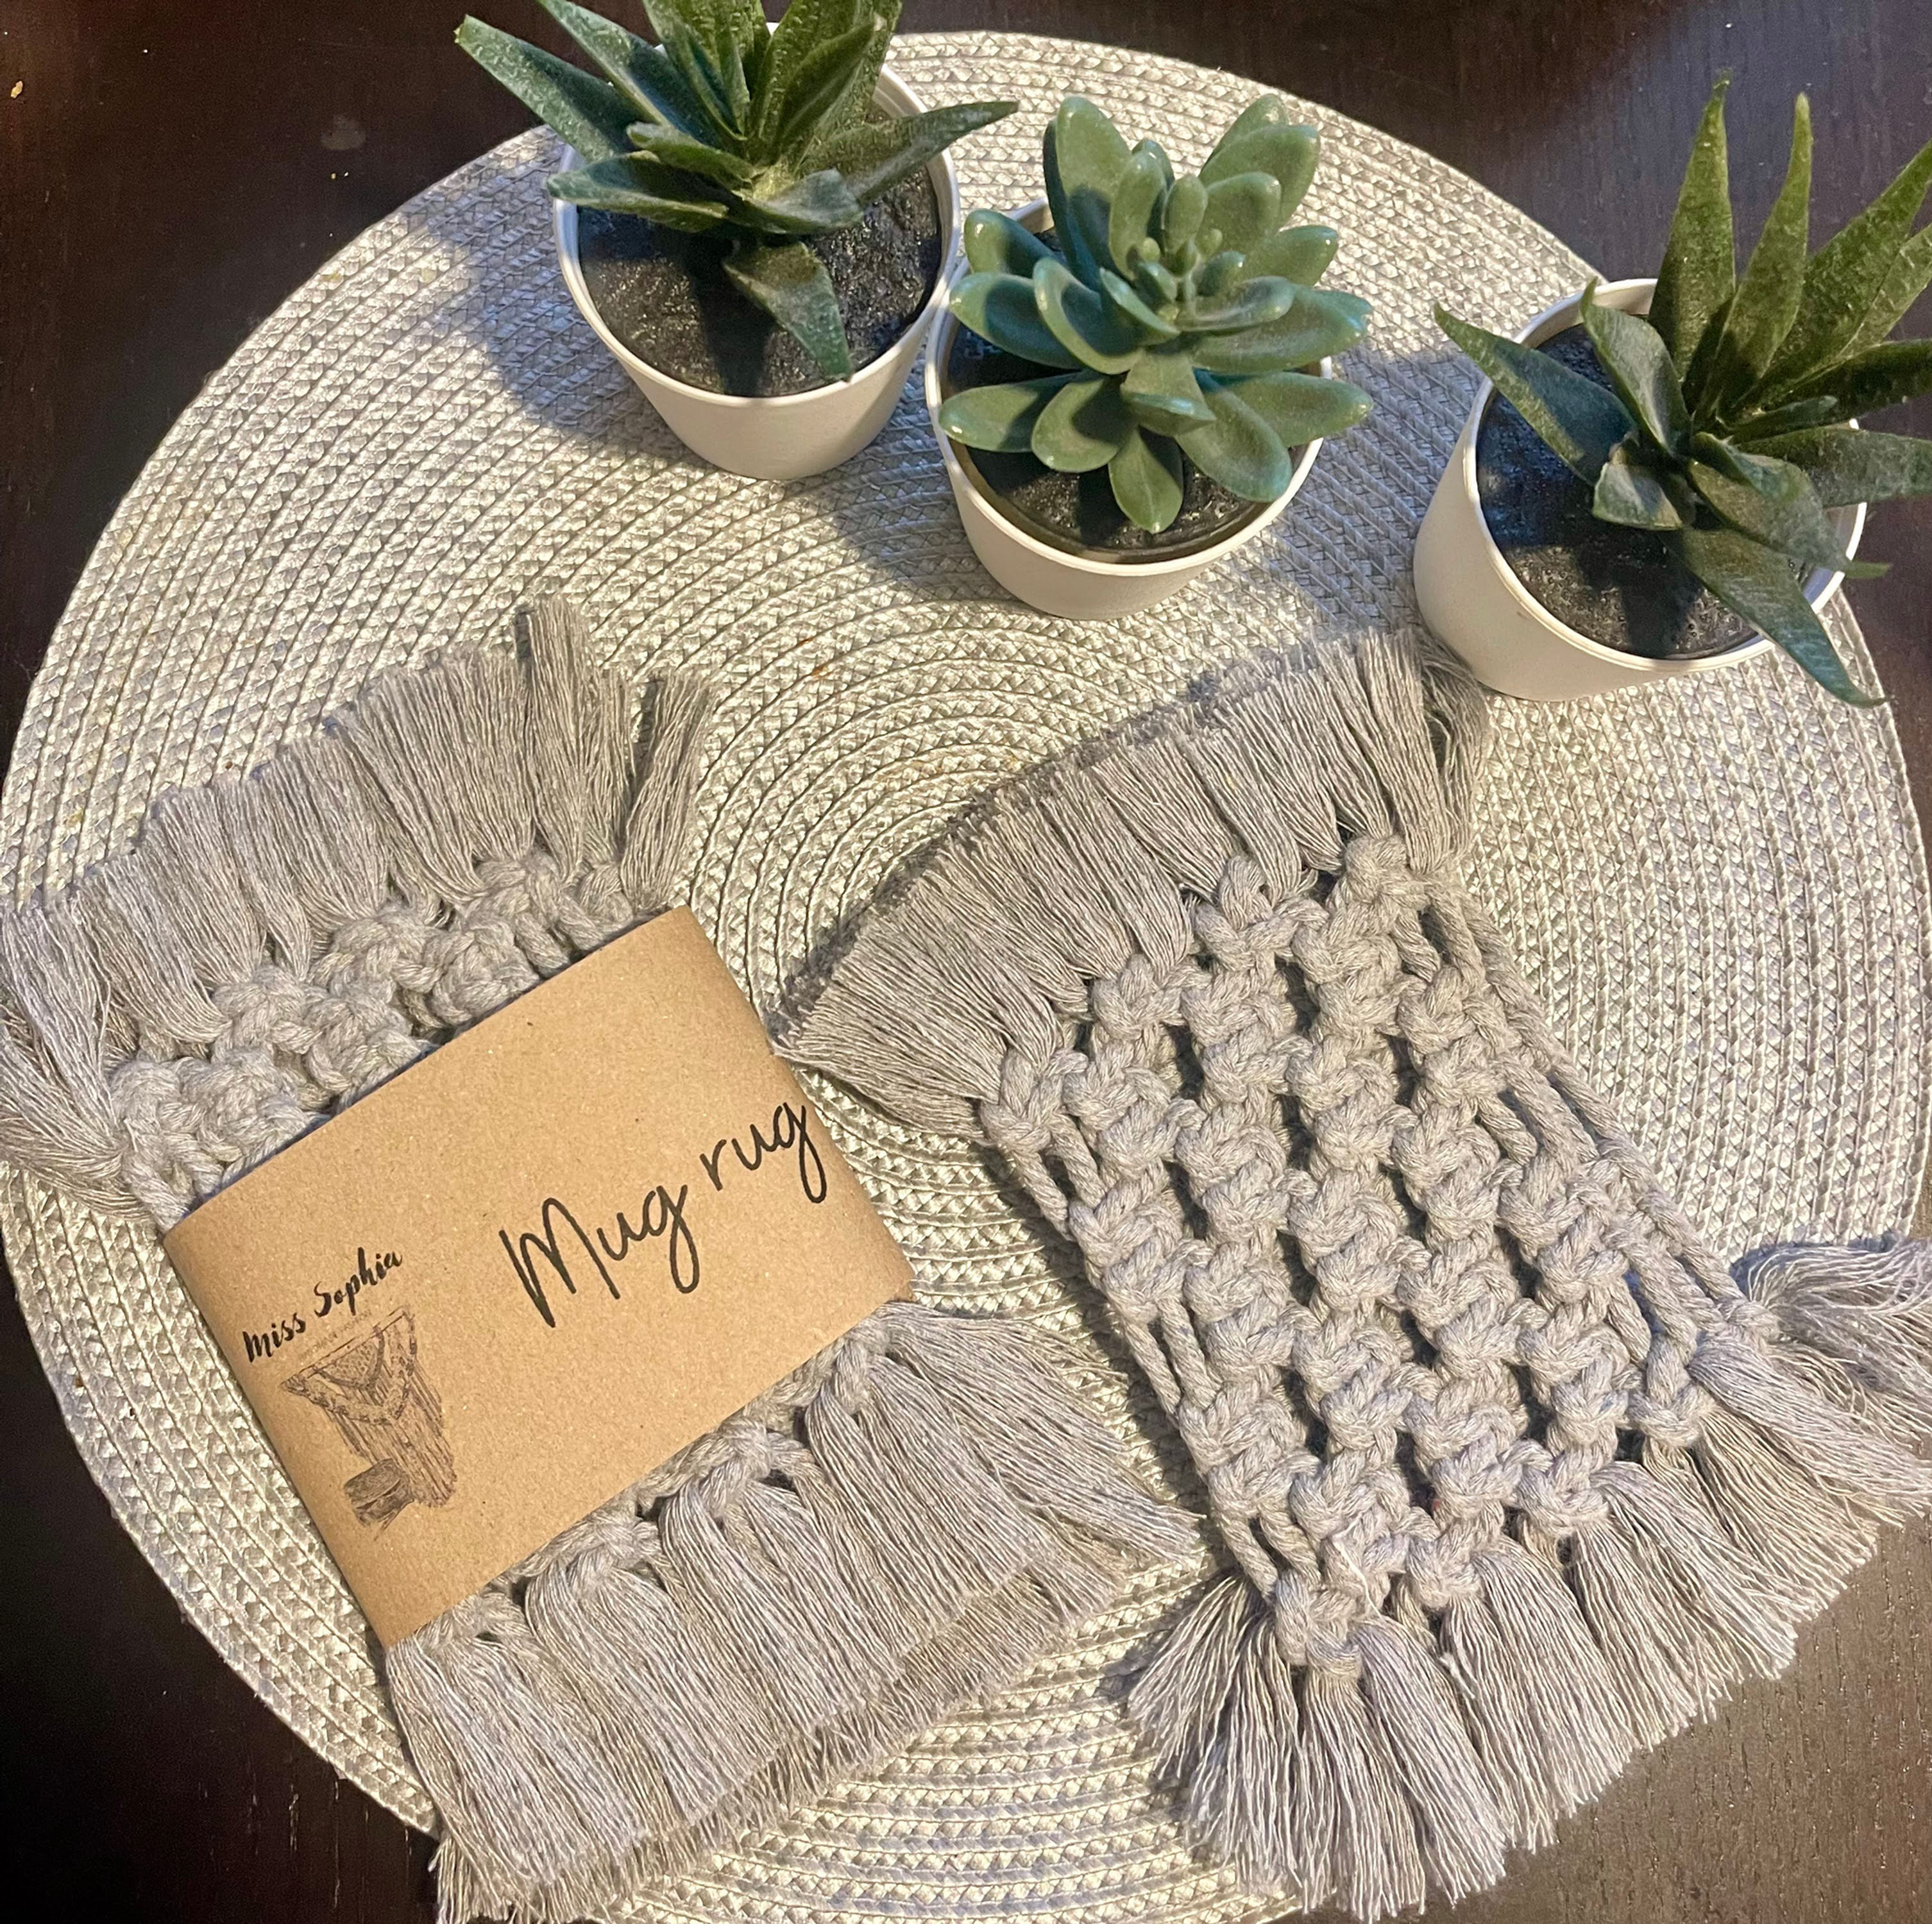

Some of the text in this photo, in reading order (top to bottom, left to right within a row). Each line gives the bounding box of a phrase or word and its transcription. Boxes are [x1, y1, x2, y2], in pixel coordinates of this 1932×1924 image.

[498, 1102, 827, 1328] Mug rug
[242, 1312, 307, 1363] Miss
[314, 1247, 403, 1317] Sophia
